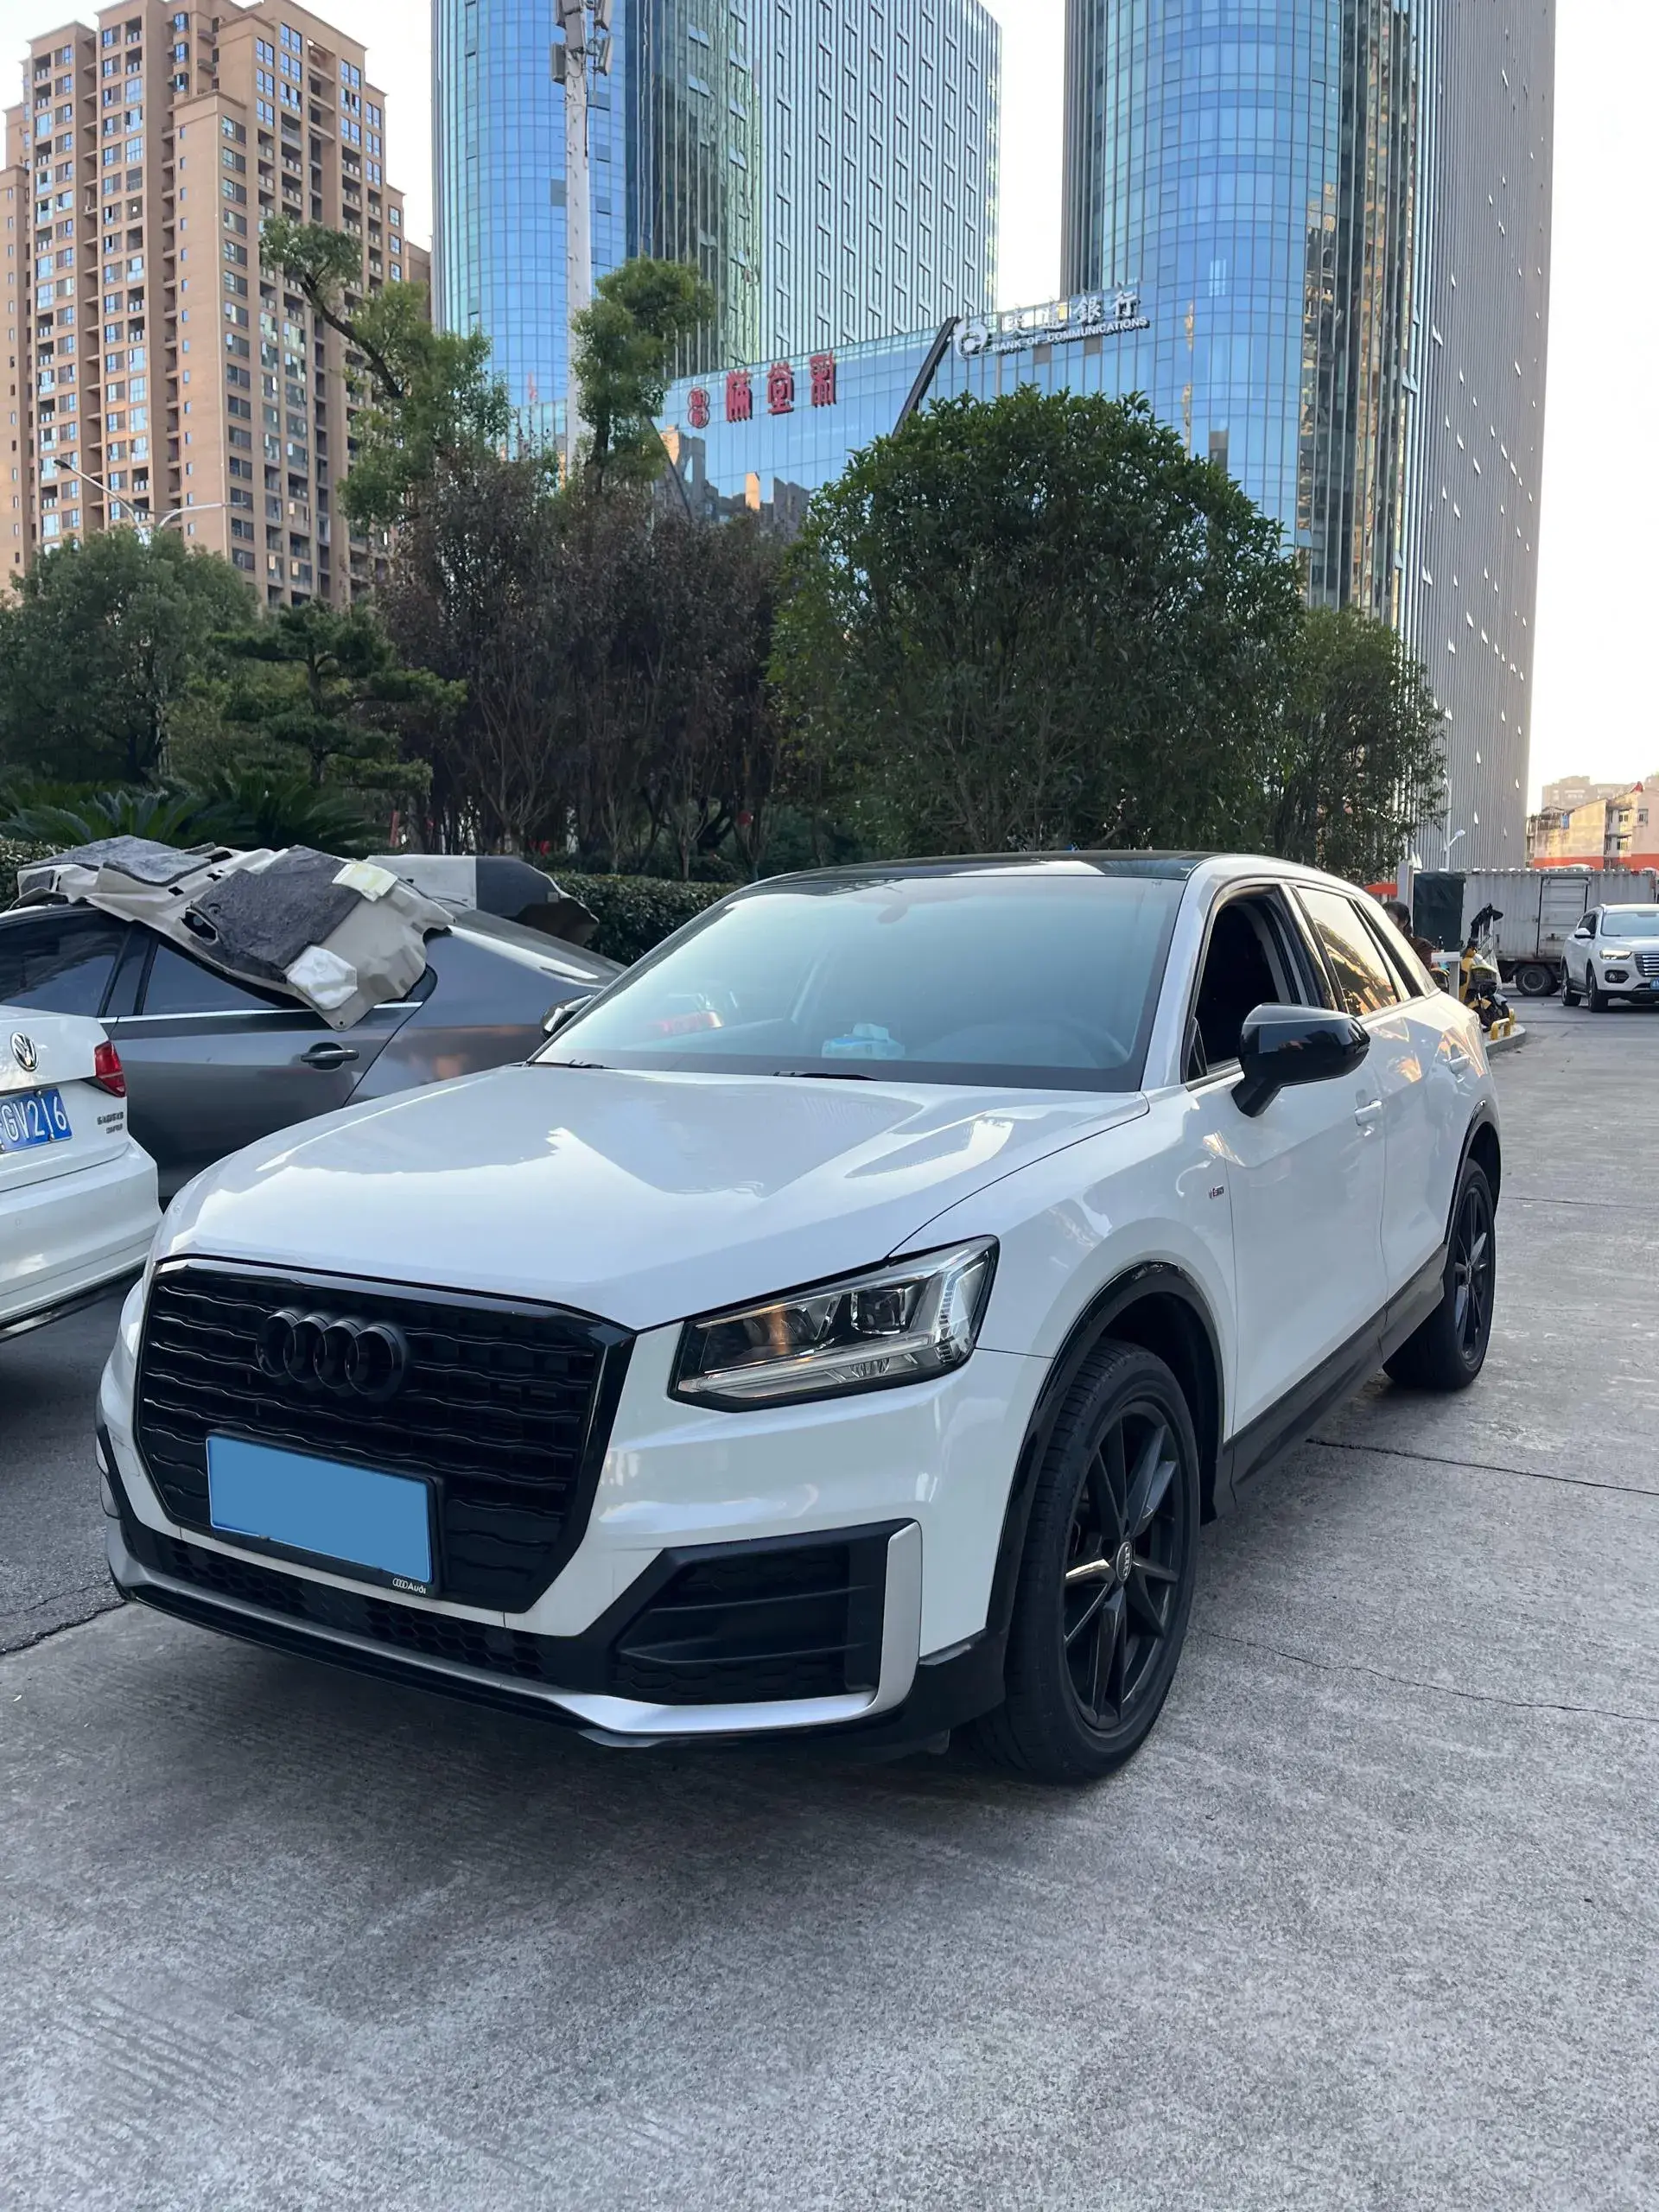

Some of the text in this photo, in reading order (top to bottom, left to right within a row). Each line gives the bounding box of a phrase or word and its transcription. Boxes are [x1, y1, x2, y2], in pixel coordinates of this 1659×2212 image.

[991, 315, 1148, 353] BANK OF COMMUNICATIONS
[407, 1583, 426, 1594] Audi
